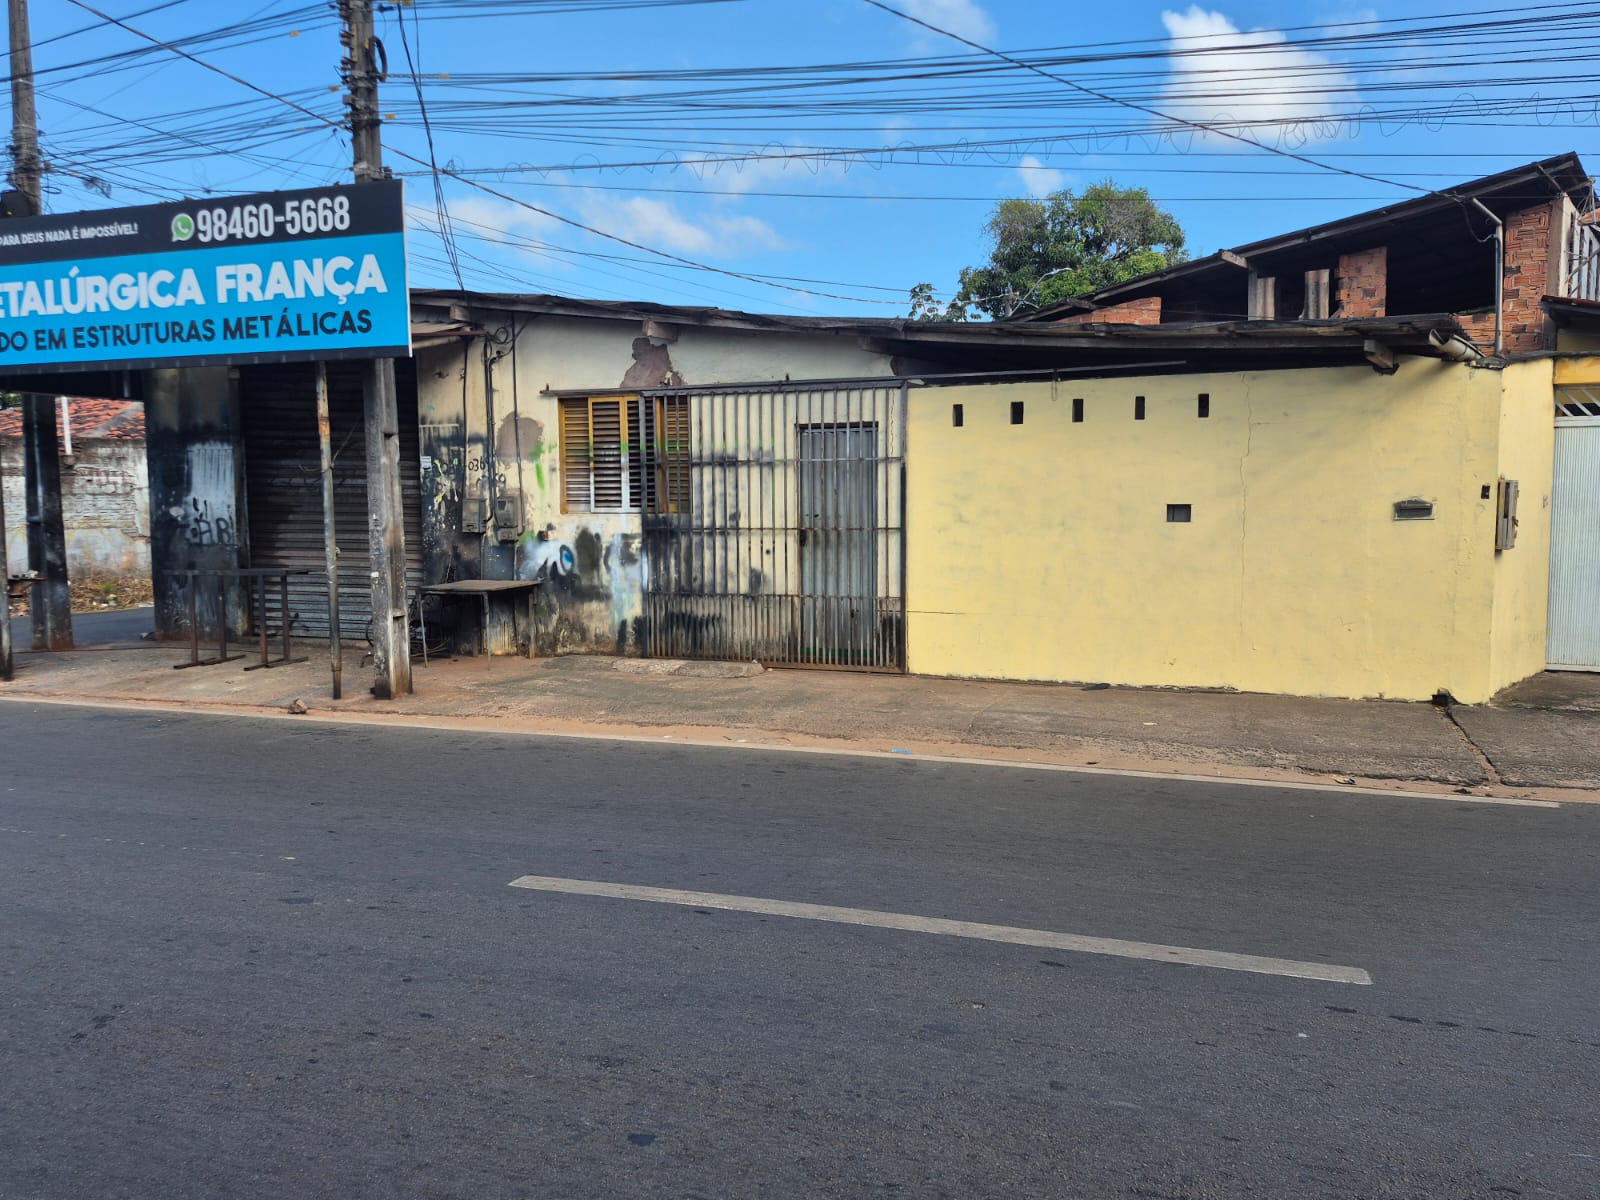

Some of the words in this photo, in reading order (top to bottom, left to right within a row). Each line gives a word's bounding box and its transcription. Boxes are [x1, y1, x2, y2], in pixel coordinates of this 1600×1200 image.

[21, 232, 44, 244] DEUS
[45, 230, 71, 242] NADA
[72, 225, 79, 239] É
[80, 222, 138, 239] IMPOSSÍVEL!
[197, 196, 350, 243] 98460-5668
[0, 265, 205, 318] TALÚRGICA
[216, 254, 387, 305] FRANÇA
[34, 328, 67, 351] EM
[73, 318, 216, 350] ESTRUTURAS
[223, 307, 373, 342] METÁLICAS
